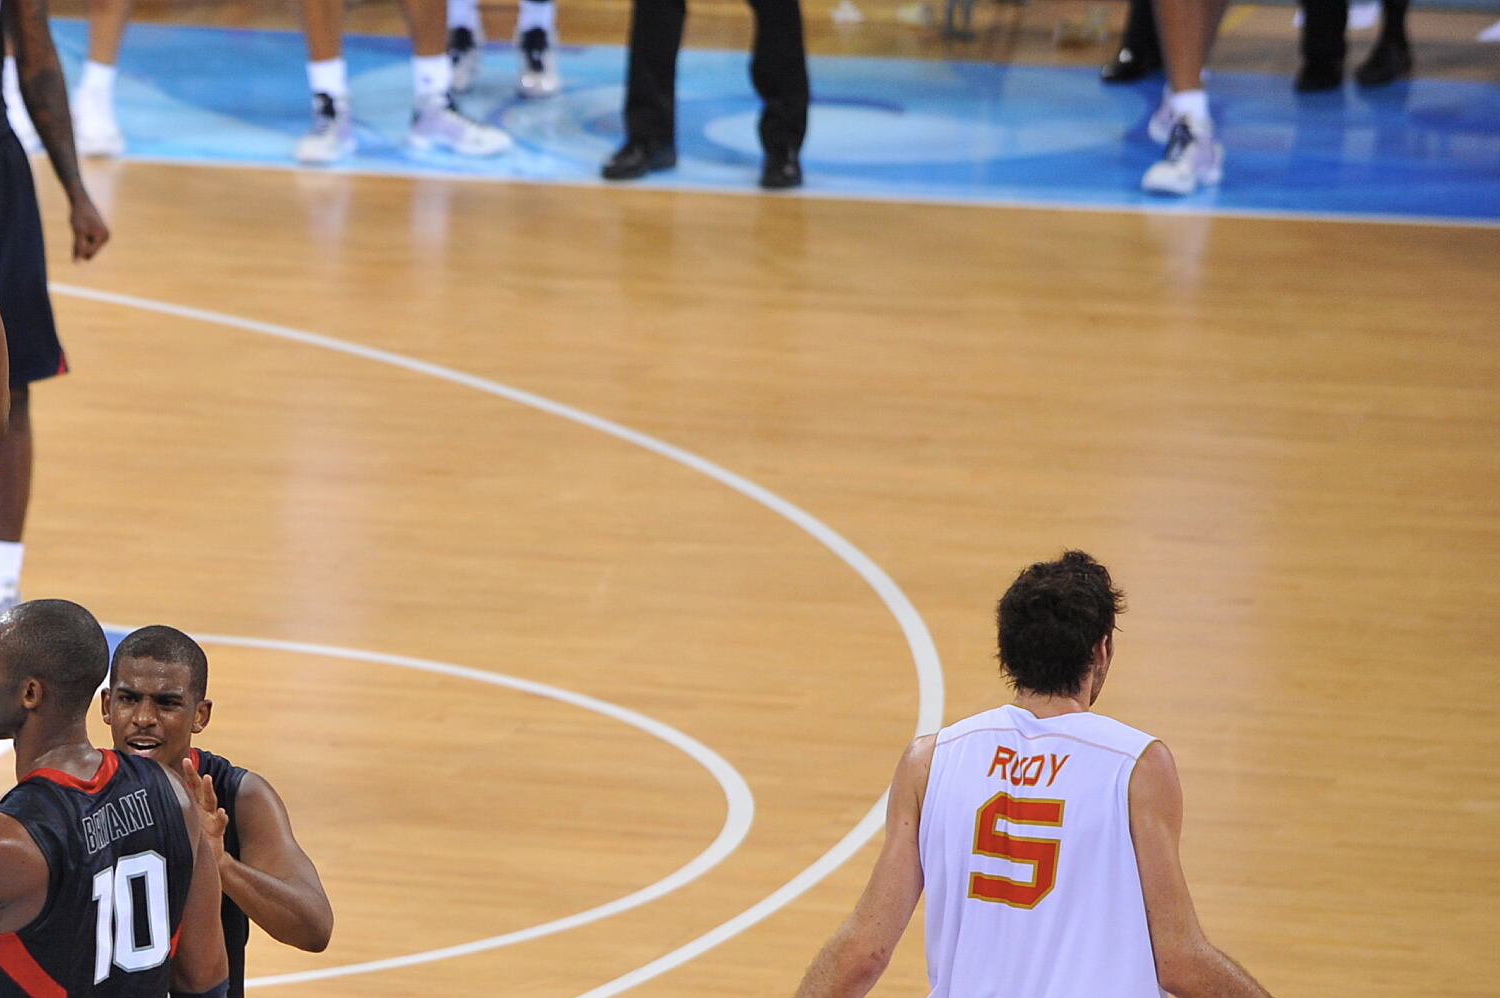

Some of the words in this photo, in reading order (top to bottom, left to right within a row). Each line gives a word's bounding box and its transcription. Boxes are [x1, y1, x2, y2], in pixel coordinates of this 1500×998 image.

[987, 744, 1071, 788] RUDY
[967, 790, 1066, 910] 5
[92, 849, 171, 985] 10
